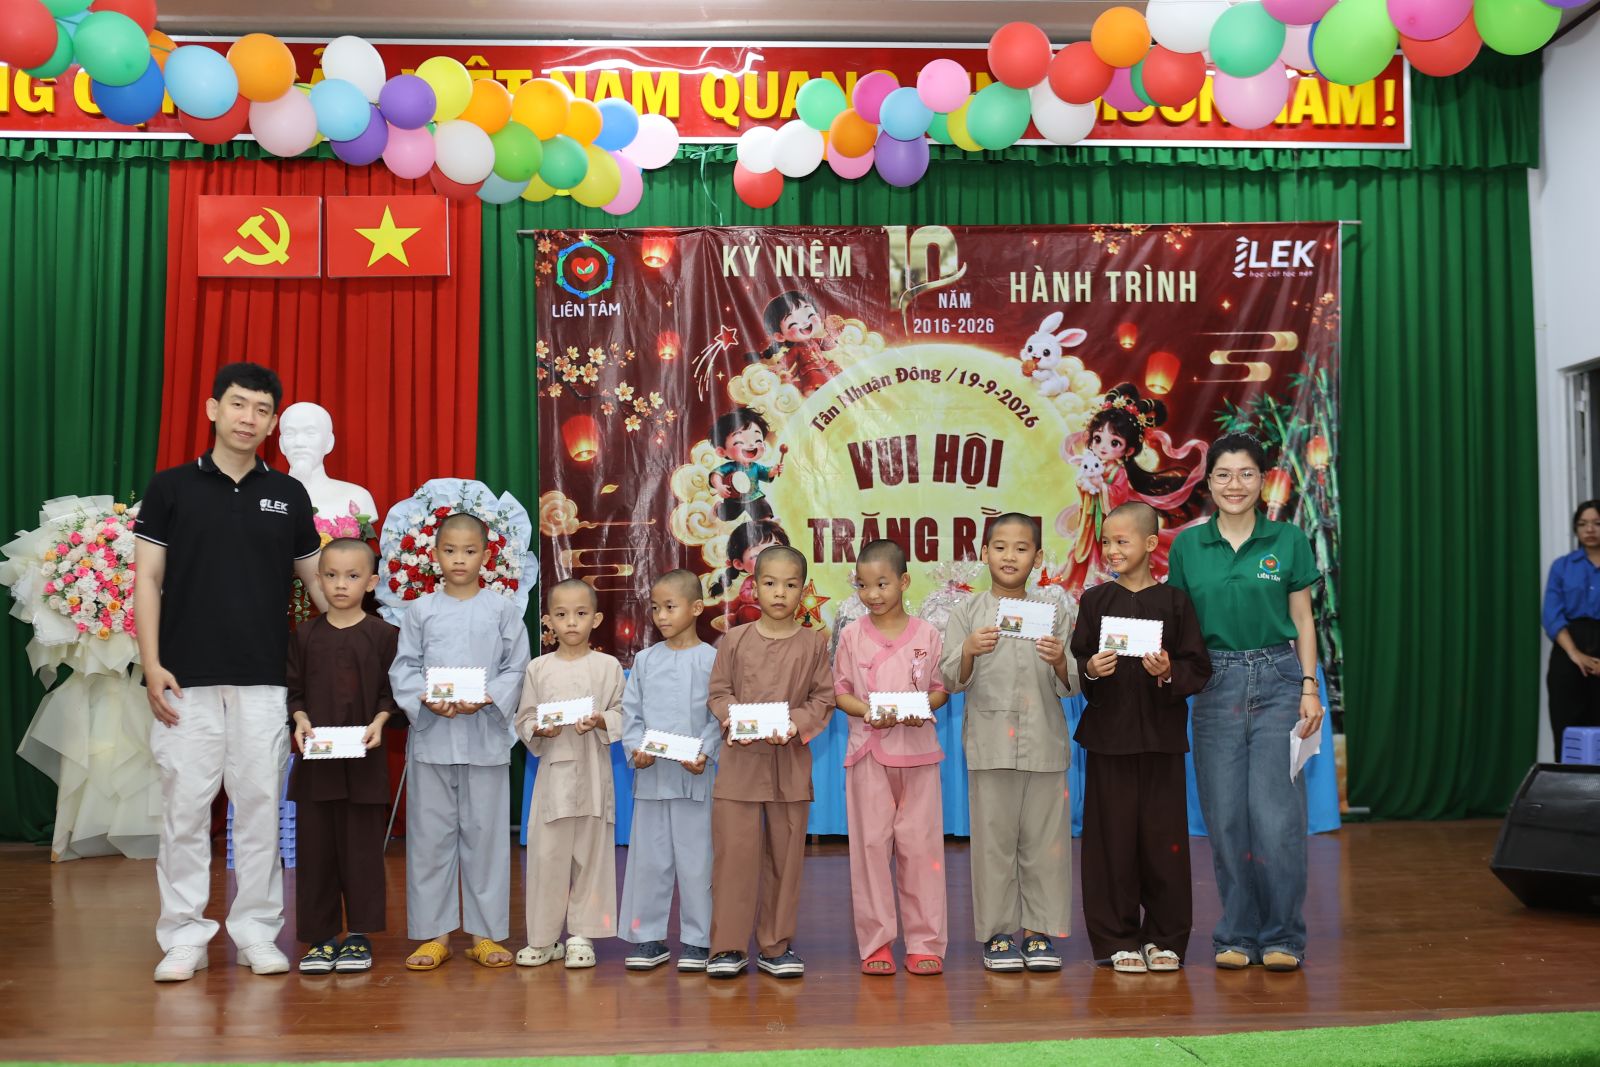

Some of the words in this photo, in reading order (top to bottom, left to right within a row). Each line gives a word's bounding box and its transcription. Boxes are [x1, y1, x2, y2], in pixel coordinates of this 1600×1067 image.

[722, 236, 760, 277] KỶ
[776, 240, 851, 283] NIỆM
[938, 289, 971, 309] NĂM
[1010, 265, 1091, 303] HÀNH
[1105, 264, 1197, 302] TRÌNH
[552, 301, 584, 318] LIÊN
[588, 300, 621, 317] TÂM
[913, 317, 994, 334] 2016-2026
[809, 404, 841, 433] Tân
[836, 374, 893, 408] Nhuận
[895, 367, 942, 383] Đông
[847, 434, 919, 490] VUI
[932, 432, 1004, 490] HỘI
[807, 511, 939, 564] TRĂNG
